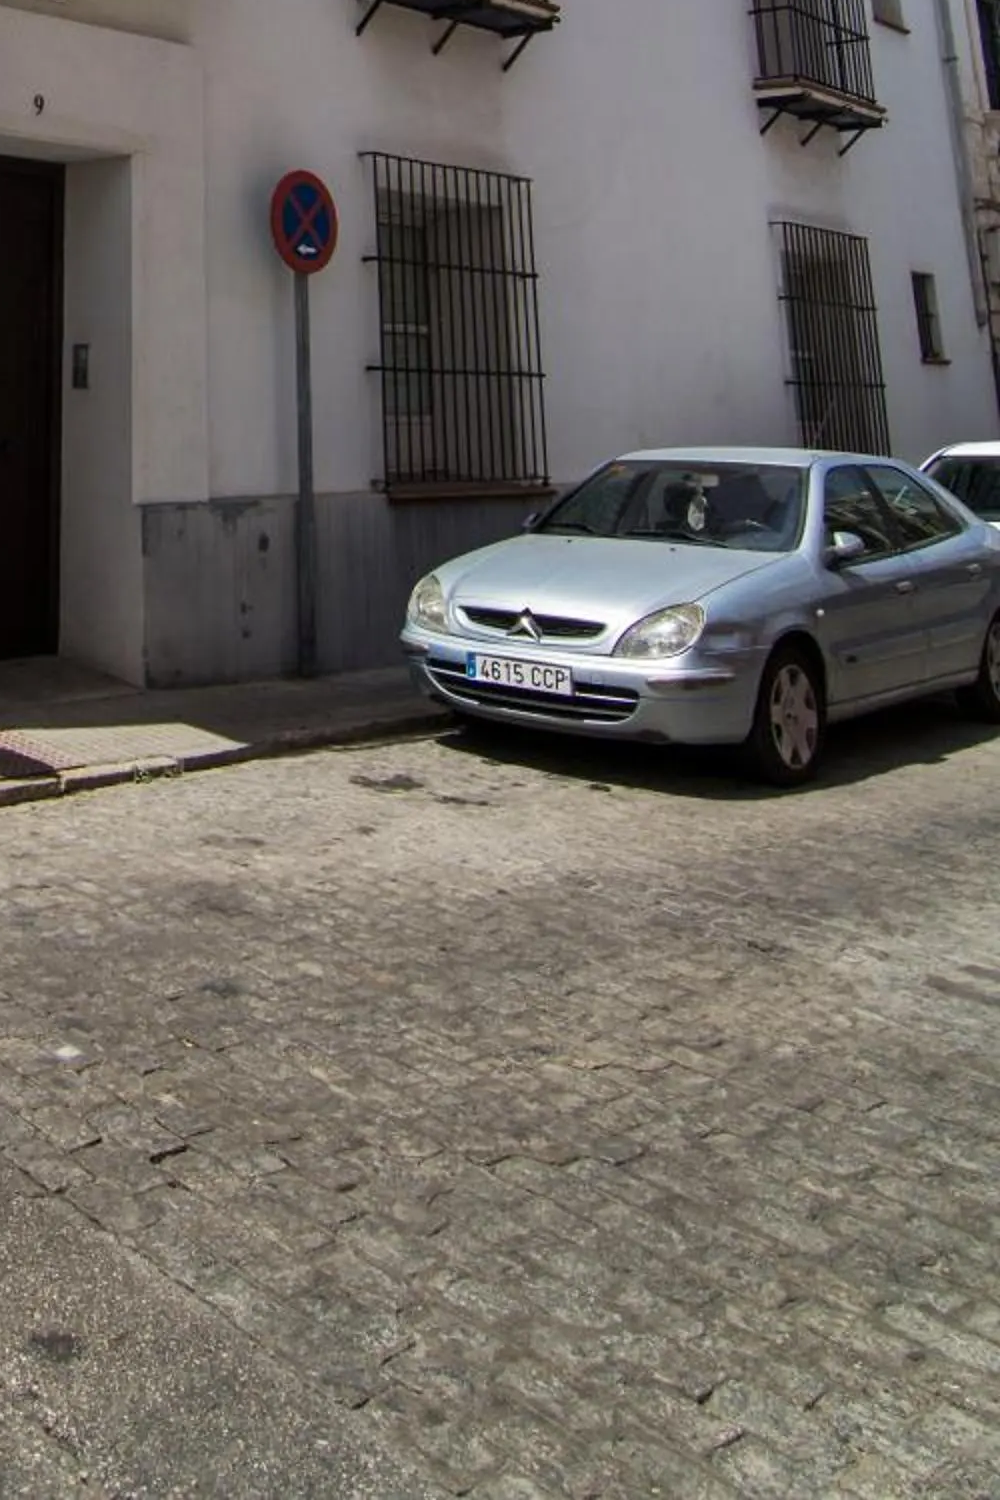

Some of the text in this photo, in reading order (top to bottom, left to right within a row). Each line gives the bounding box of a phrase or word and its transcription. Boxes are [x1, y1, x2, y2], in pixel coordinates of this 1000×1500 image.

[33, 94, 45, 116] 9
[481, 660, 565, 690] 4615 CCP
